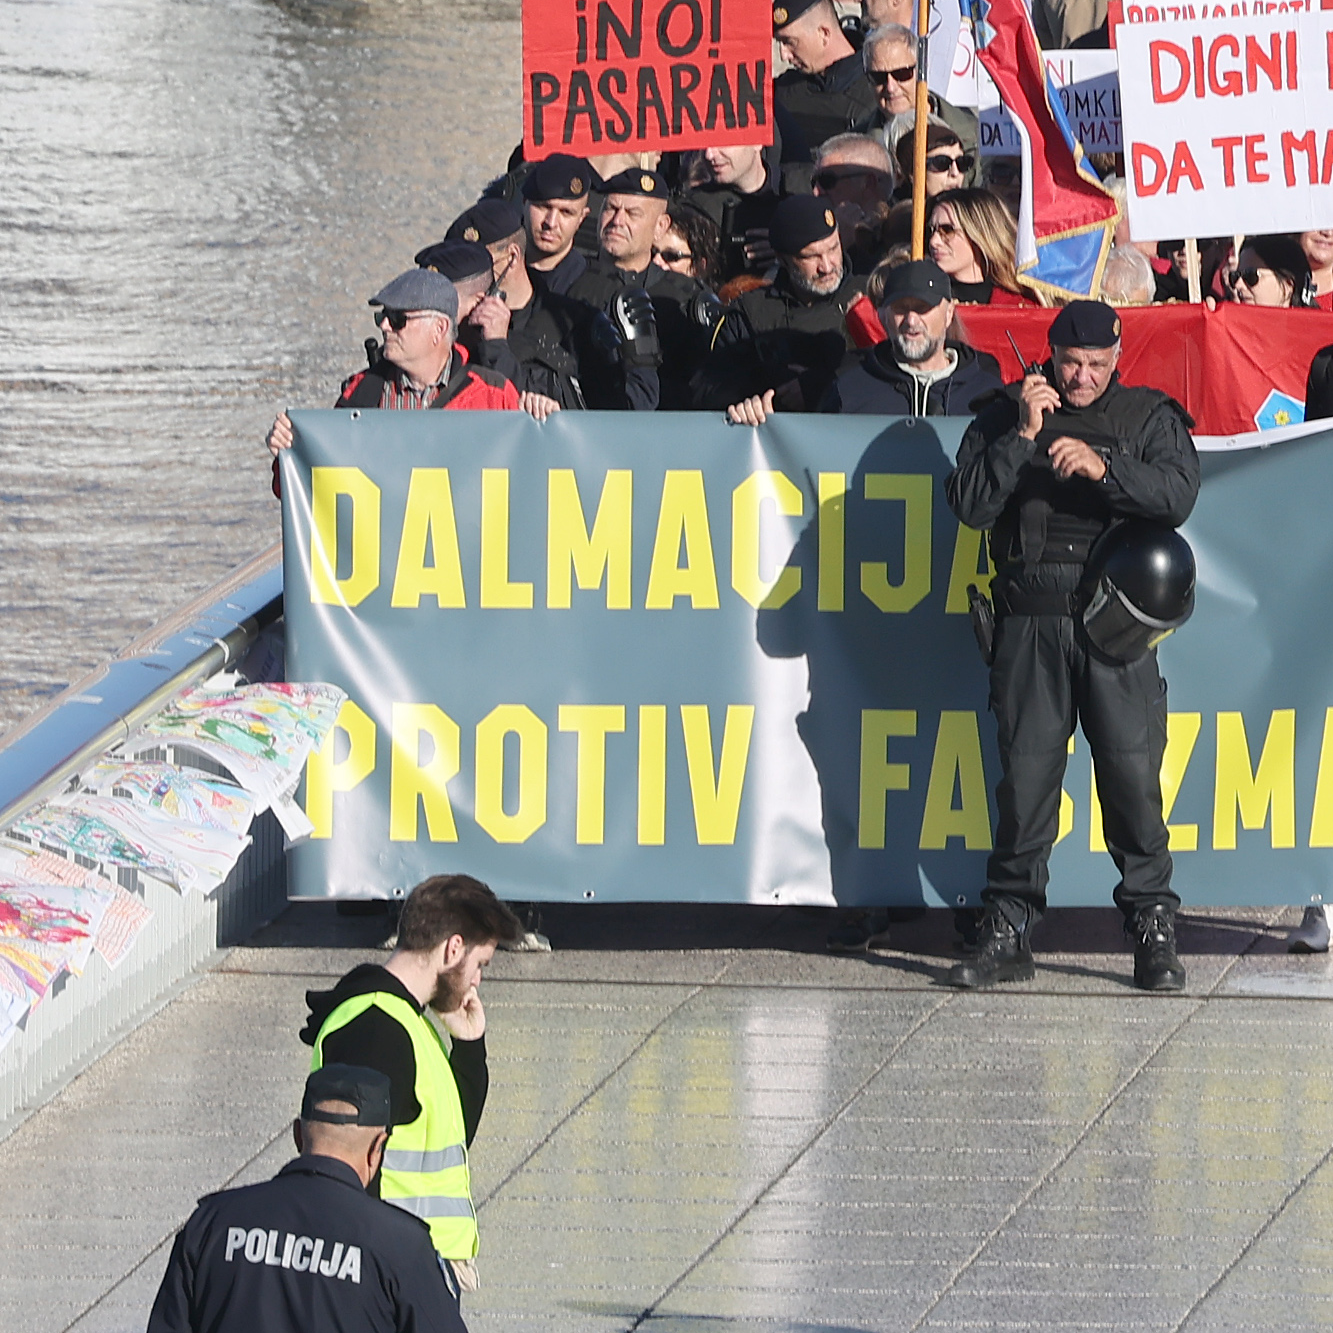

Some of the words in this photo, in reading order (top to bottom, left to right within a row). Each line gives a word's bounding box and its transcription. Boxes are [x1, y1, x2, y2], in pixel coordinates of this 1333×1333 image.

[530, 59, 767, 147] PASARAN
[1149, 29, 1299, 104] DIGNI
[1131, 139, 1205, 198] DA
[1210, 134, 1270, 188] TE
[310, 466, 996, 615] DALMACIJA
[303, 703, 755, 846] PROTIV
[225, 1226, 362, 1285] POLICIJA
